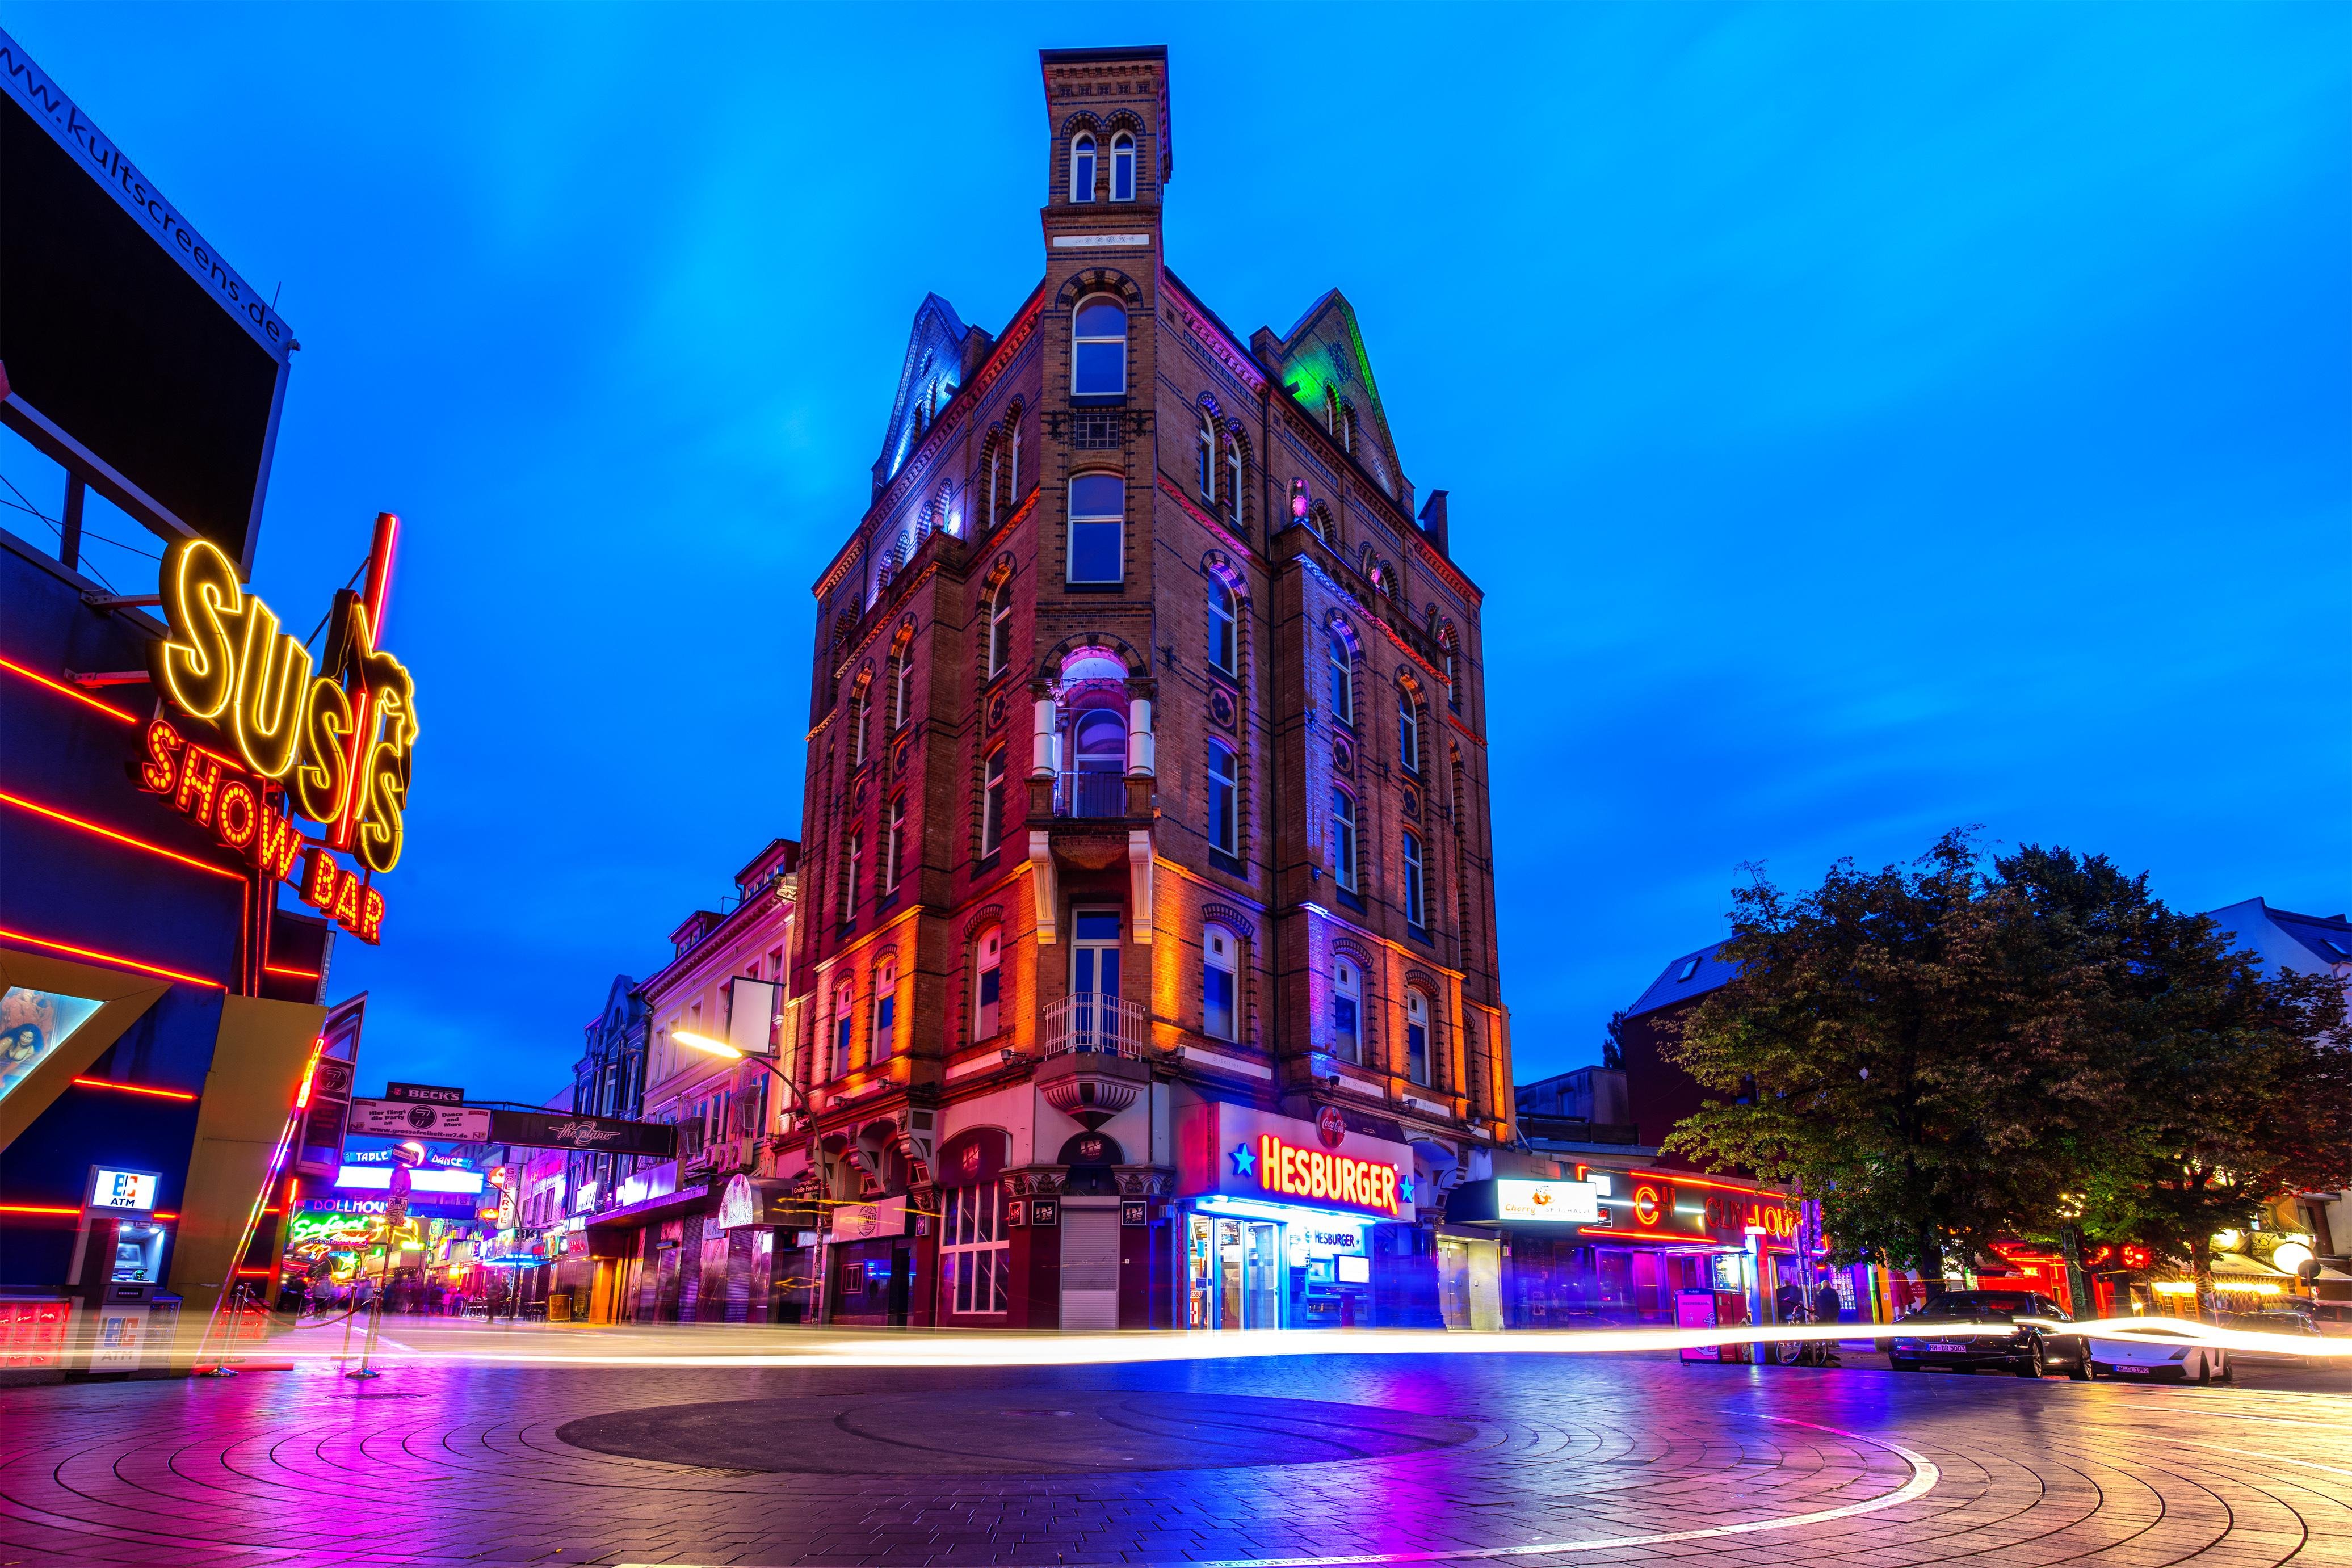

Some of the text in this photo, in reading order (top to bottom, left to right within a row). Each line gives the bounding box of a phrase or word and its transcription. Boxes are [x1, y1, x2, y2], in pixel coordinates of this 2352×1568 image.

[142, 719, 385, 946] SHOW BAR
[408, 1088, 460, 1102] BECK'S
[369, 1127, 468, 1139] www.grossefreiheit-nr7.de
[575, 1121, 620, 1146] plane
[356, 1151, 389, 1161] TABLE
[431, 1154, 463, 1166] DANCE
[1260, 1134, 1398, 1215] HESBURGER
[110, 1198, 135, 1207] ATM
[1505, 1204, 1536, 1215] Cherry
[293, 1215, 369, 1239] Safari
[1314, 1230, 1355, 1247] HESBURGER
